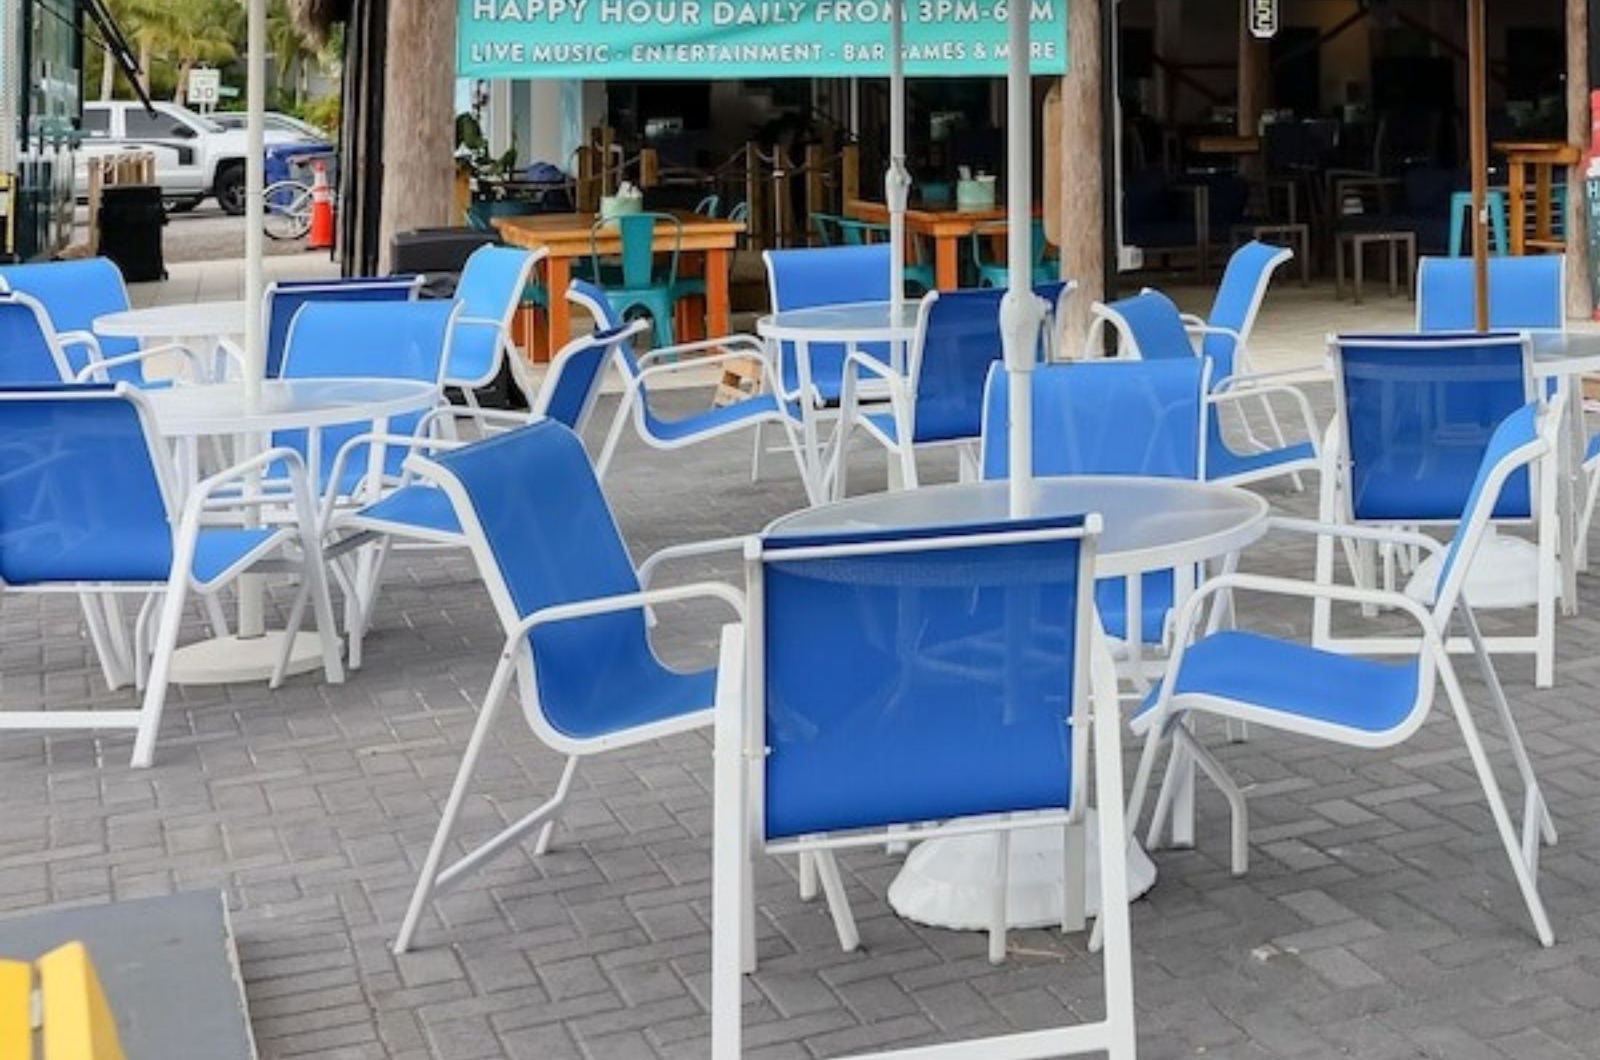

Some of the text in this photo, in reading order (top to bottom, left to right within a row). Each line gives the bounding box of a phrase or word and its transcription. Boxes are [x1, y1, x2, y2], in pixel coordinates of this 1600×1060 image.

[713, 0, 807, 25] DAILY
[919, 0, 1054, 22] 3PM-6M
[471, 43, 525, 63] LIVE
[532, 44, 610, 63] MUSIC
[631, 43, 822, 62] ENTERTAINMENT
[843, 42, 885, 60] BAR
[976, 42, 986, 59] &
[993, 42, 1056, 60] MRE
